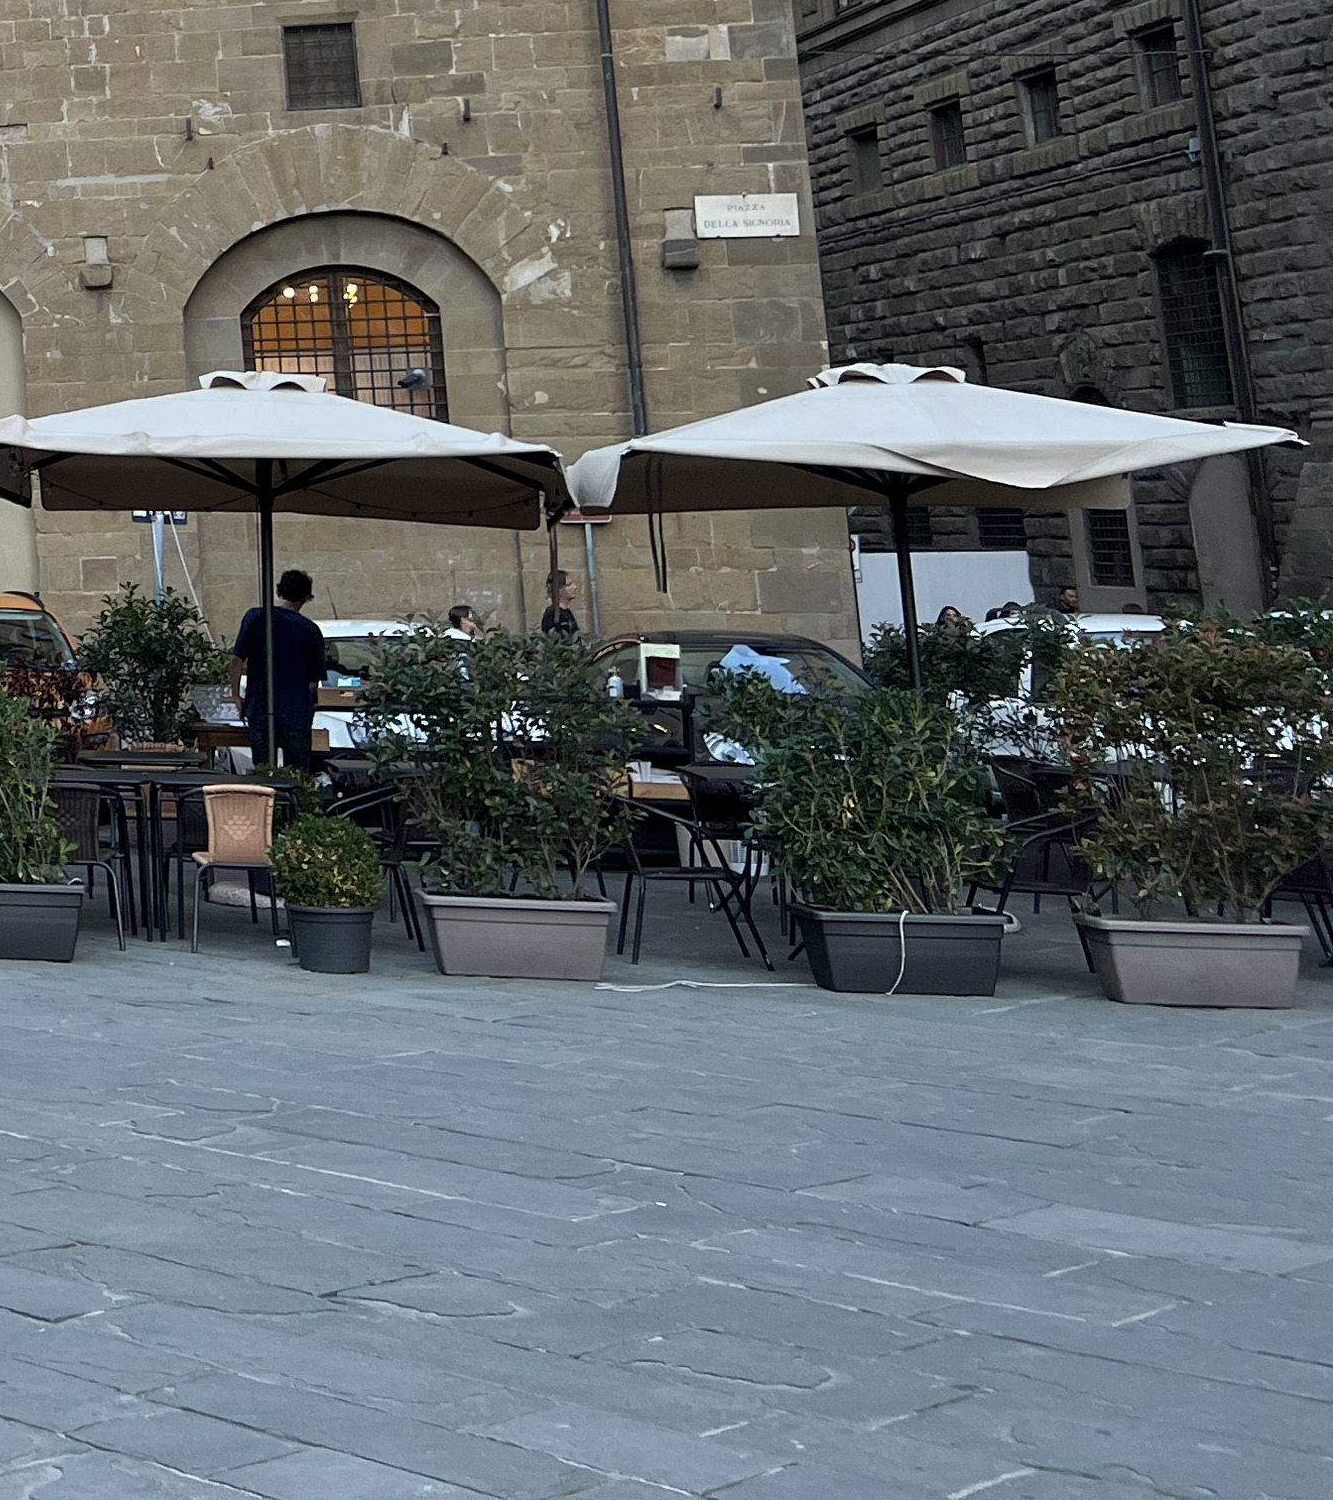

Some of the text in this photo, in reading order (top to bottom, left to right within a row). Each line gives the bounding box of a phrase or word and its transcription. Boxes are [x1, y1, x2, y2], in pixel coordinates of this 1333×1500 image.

[727, 203, 766, 212] PIAZZA
[703, 217, 791, 229] DELLA SIGNORIA
